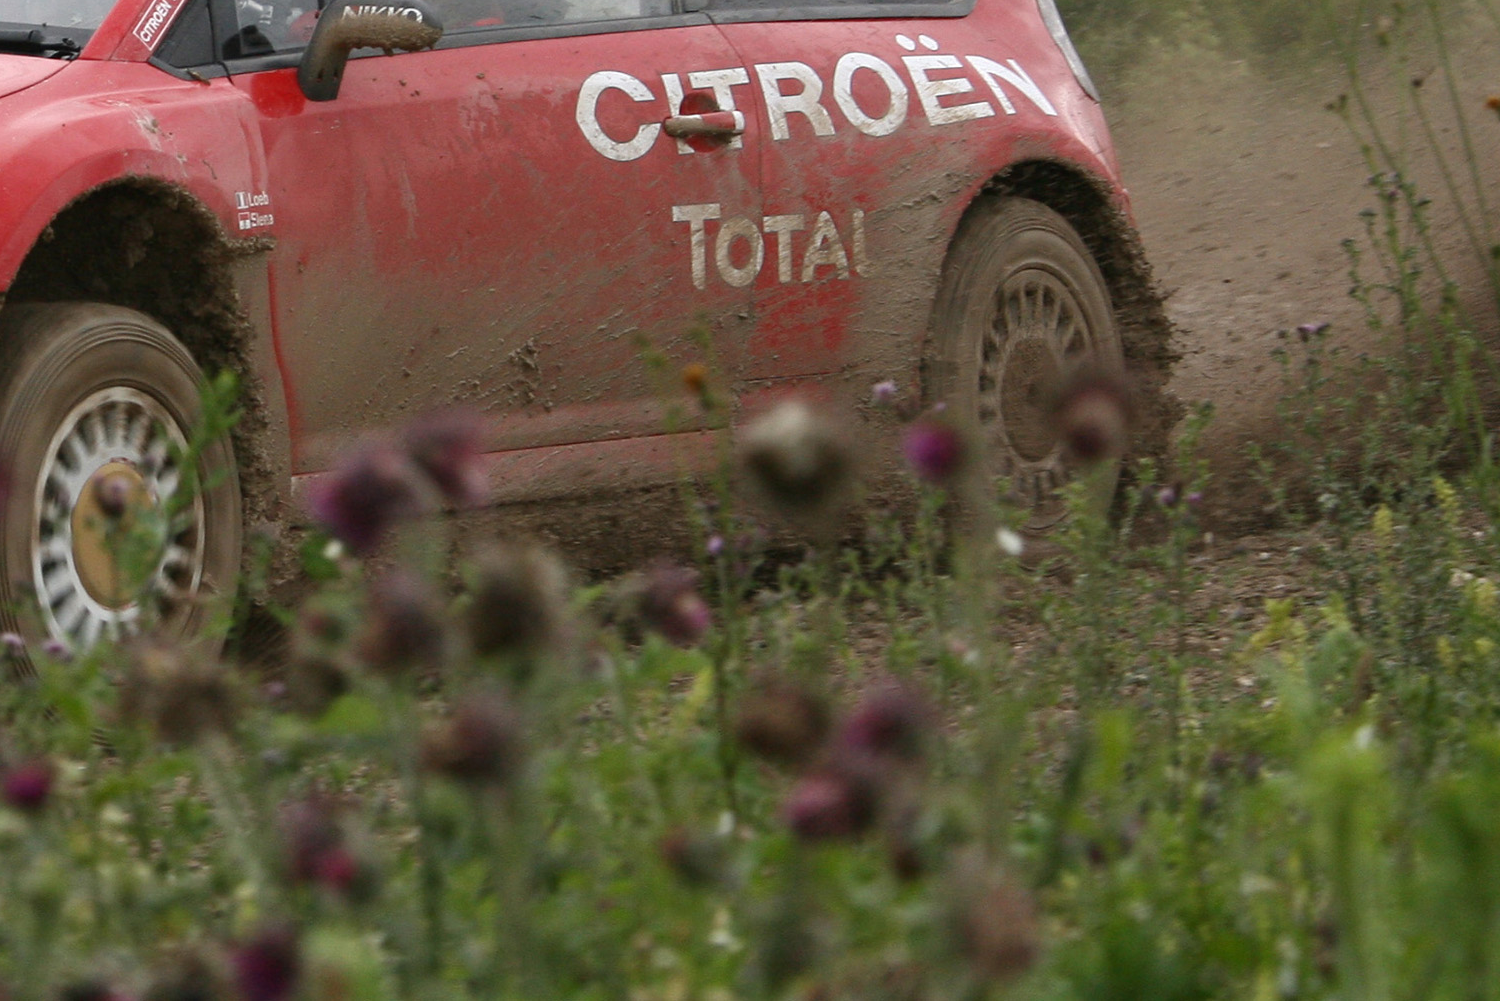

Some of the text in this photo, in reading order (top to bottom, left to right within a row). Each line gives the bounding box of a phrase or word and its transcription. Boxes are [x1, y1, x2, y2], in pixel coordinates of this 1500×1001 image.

[139, 0, 173, 43] CITROËN
[575, 34, 1058, 162] CITROËN
[247, 190, 270, 207] Loeb
